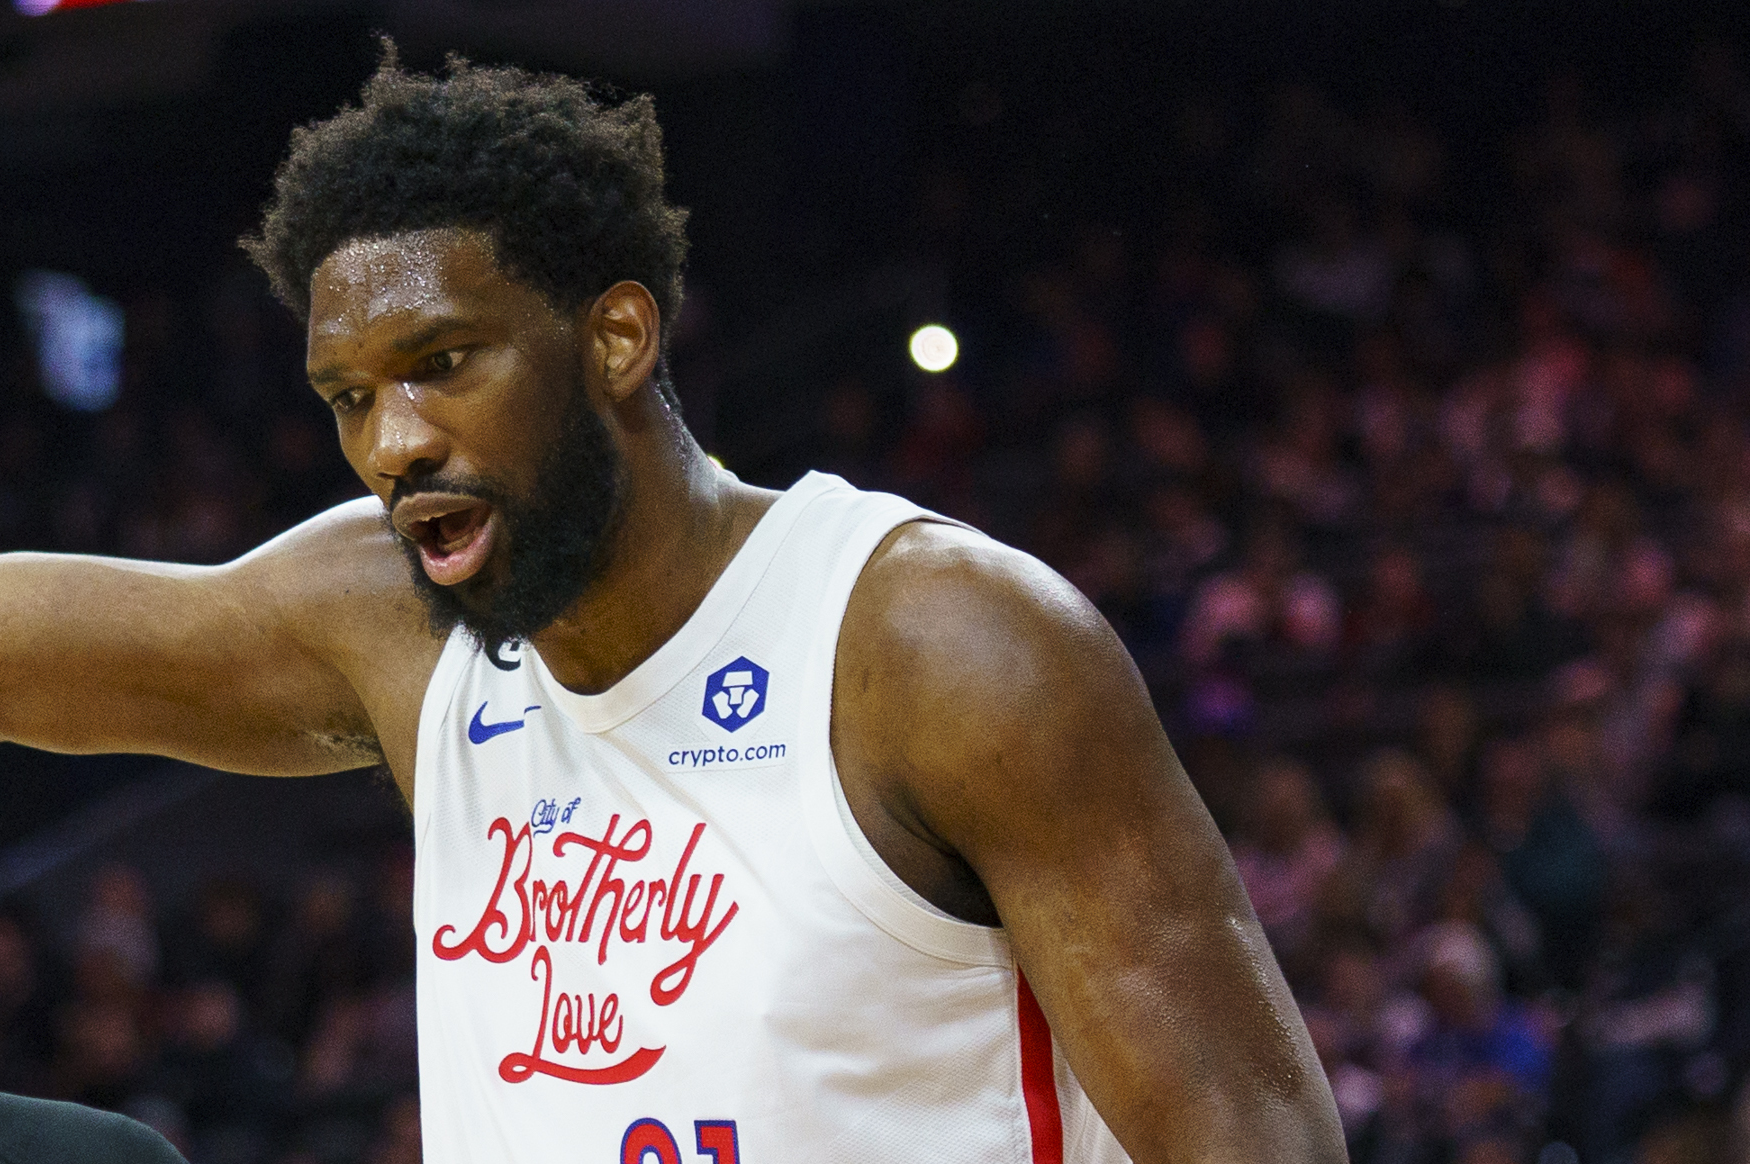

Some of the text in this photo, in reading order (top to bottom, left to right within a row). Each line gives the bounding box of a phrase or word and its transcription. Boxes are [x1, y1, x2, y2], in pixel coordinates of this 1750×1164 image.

[668, 744, 786, 768] crypto.com
[531, 796, 582, 838] City of
[498, 945, 667, 1085] Love
